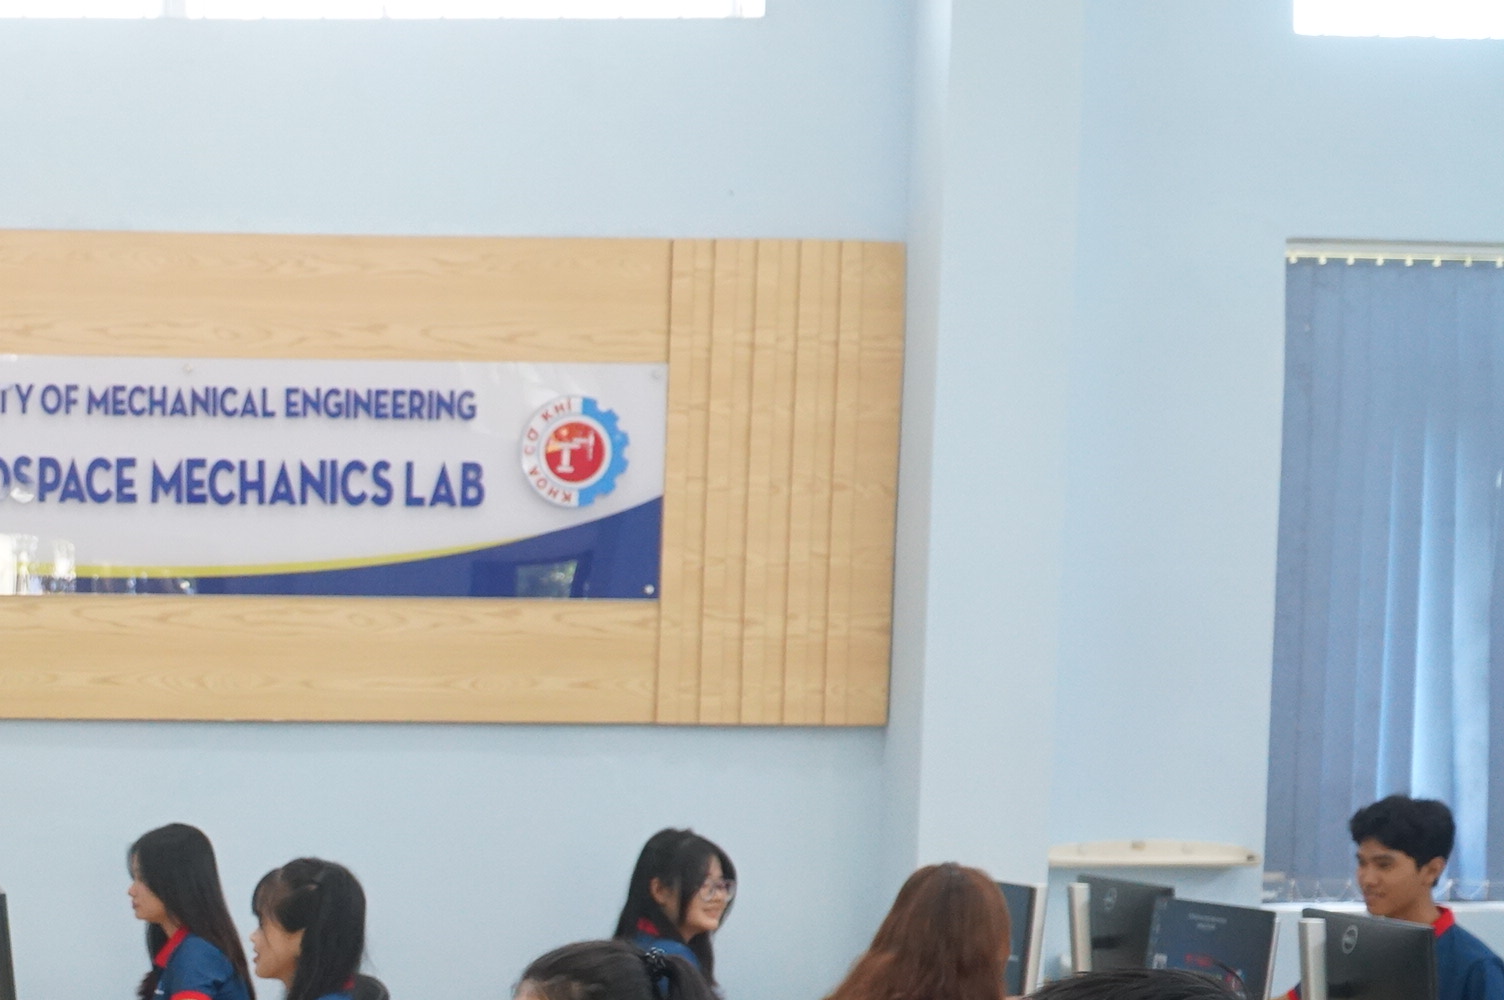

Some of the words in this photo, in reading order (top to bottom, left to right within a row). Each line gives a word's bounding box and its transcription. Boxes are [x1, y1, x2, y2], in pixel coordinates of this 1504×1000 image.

[41, 384, 79, 416] OF
[87, 385, 276, 417] MECHANICAL
[285, 387, 477, 421] ENGINEERING
[151, 458, 394, 507] MECHANICS
[404, 461, 486, 508] LAB
